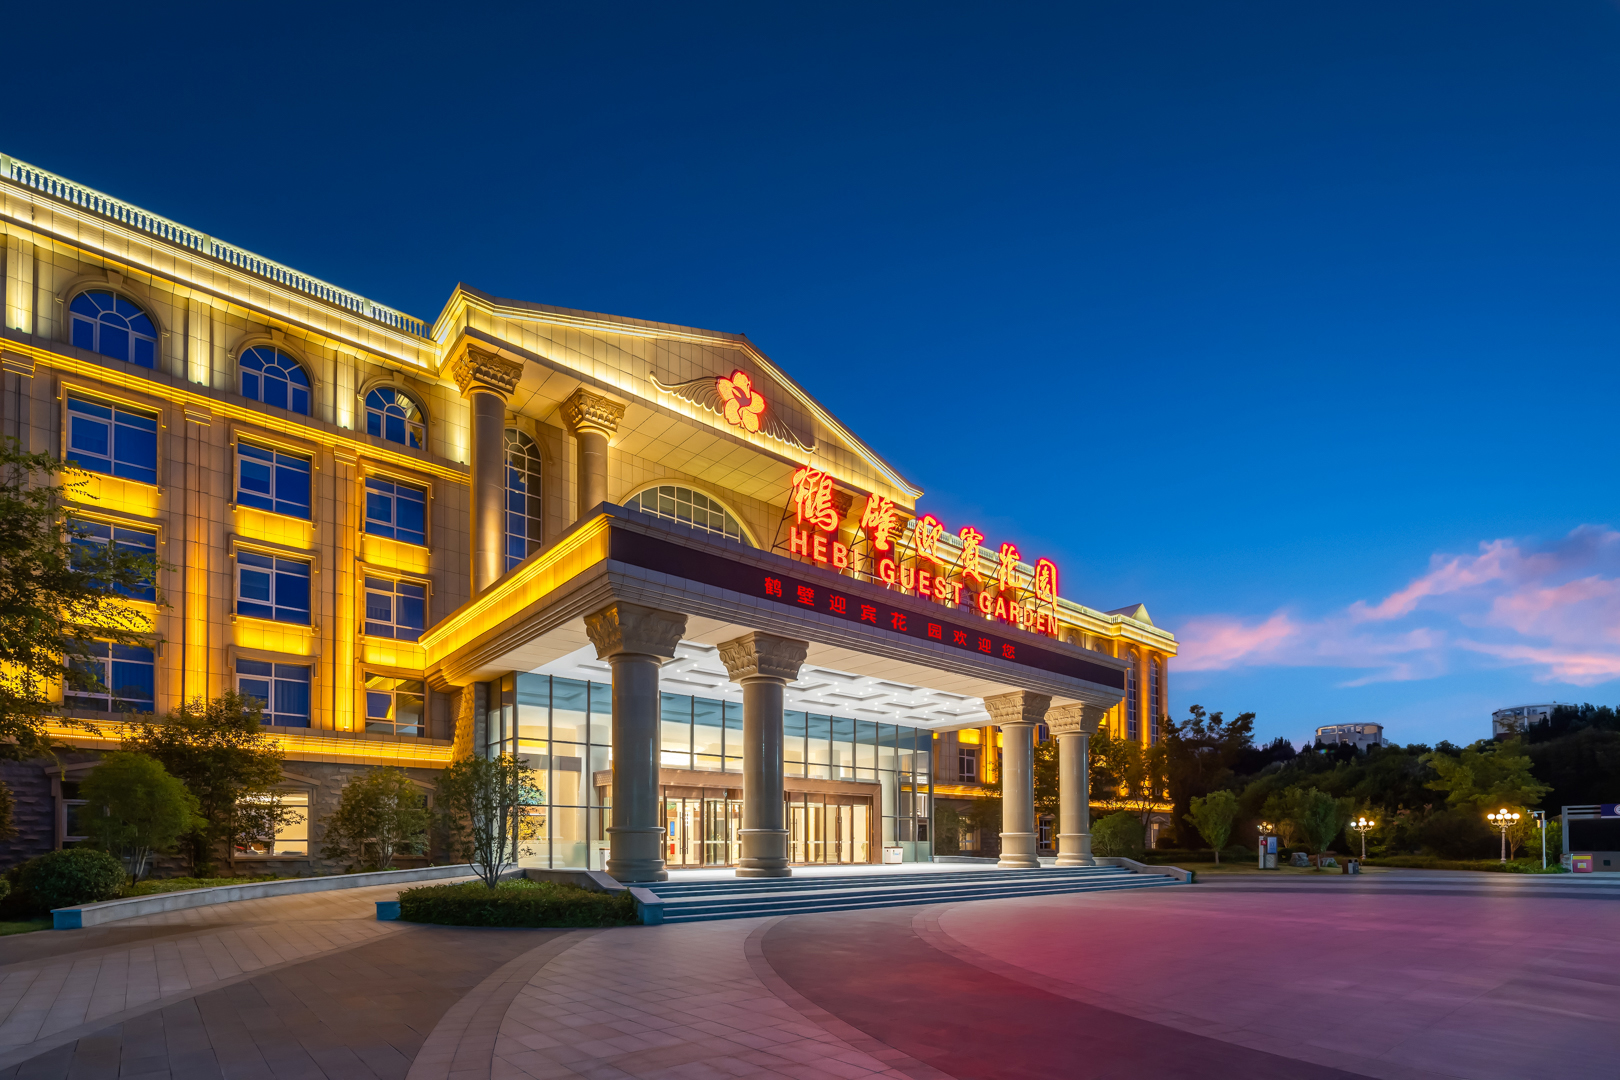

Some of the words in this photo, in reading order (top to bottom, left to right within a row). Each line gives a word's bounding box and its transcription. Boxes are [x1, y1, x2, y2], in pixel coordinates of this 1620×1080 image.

[790, 526, 859, 574] HEBI
[879, 559, 963, 604] GUEST
[979, 592, 1058, 635] GARDEN
